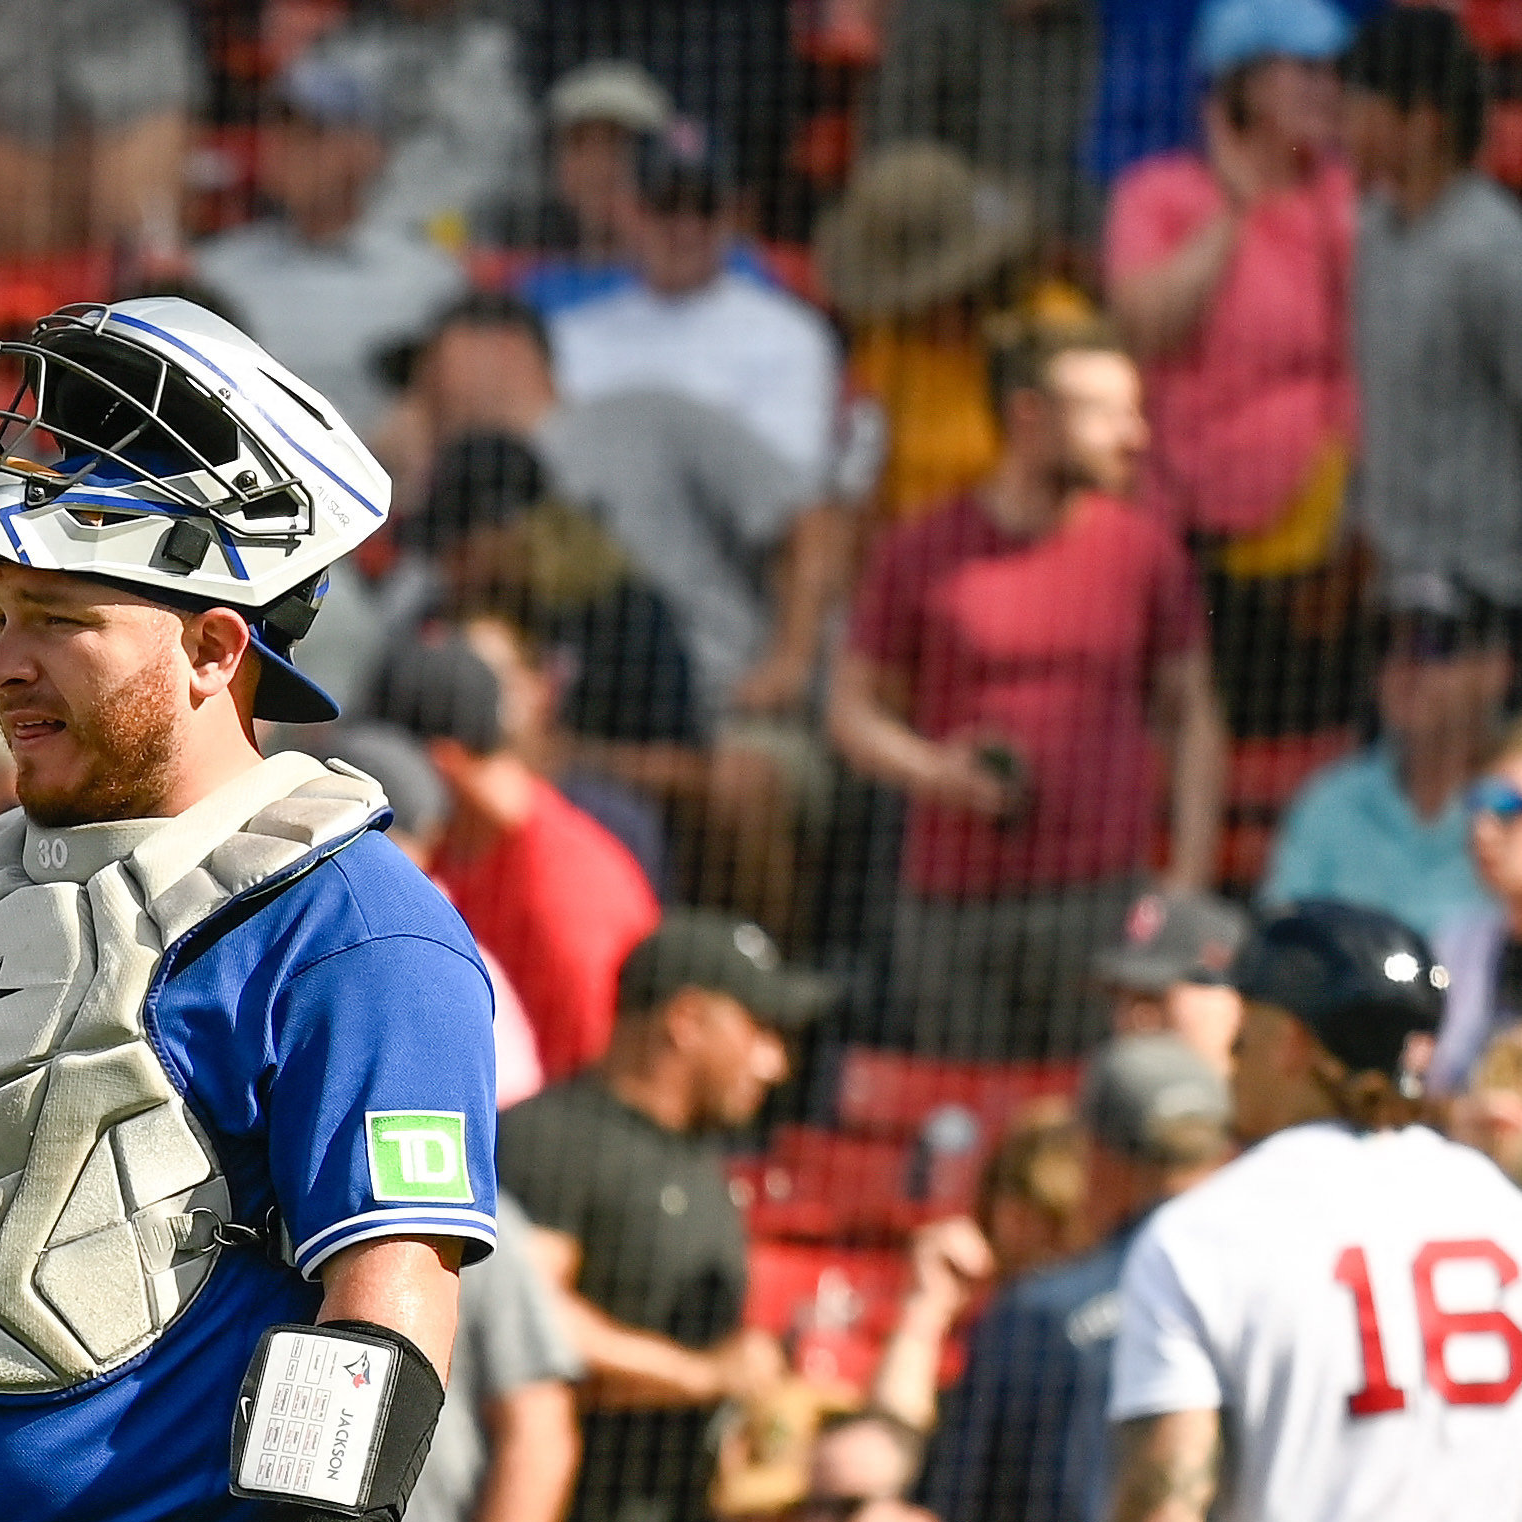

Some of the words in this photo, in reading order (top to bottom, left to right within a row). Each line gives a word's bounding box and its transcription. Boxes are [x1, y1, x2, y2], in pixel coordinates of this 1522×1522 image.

[38, 838, 68, 869] 30
[381, 1129, 458, 1183] TD
[1334, 1239, 1522, 1416] 16
[326, 1408, 354, 1481] JACKSON
